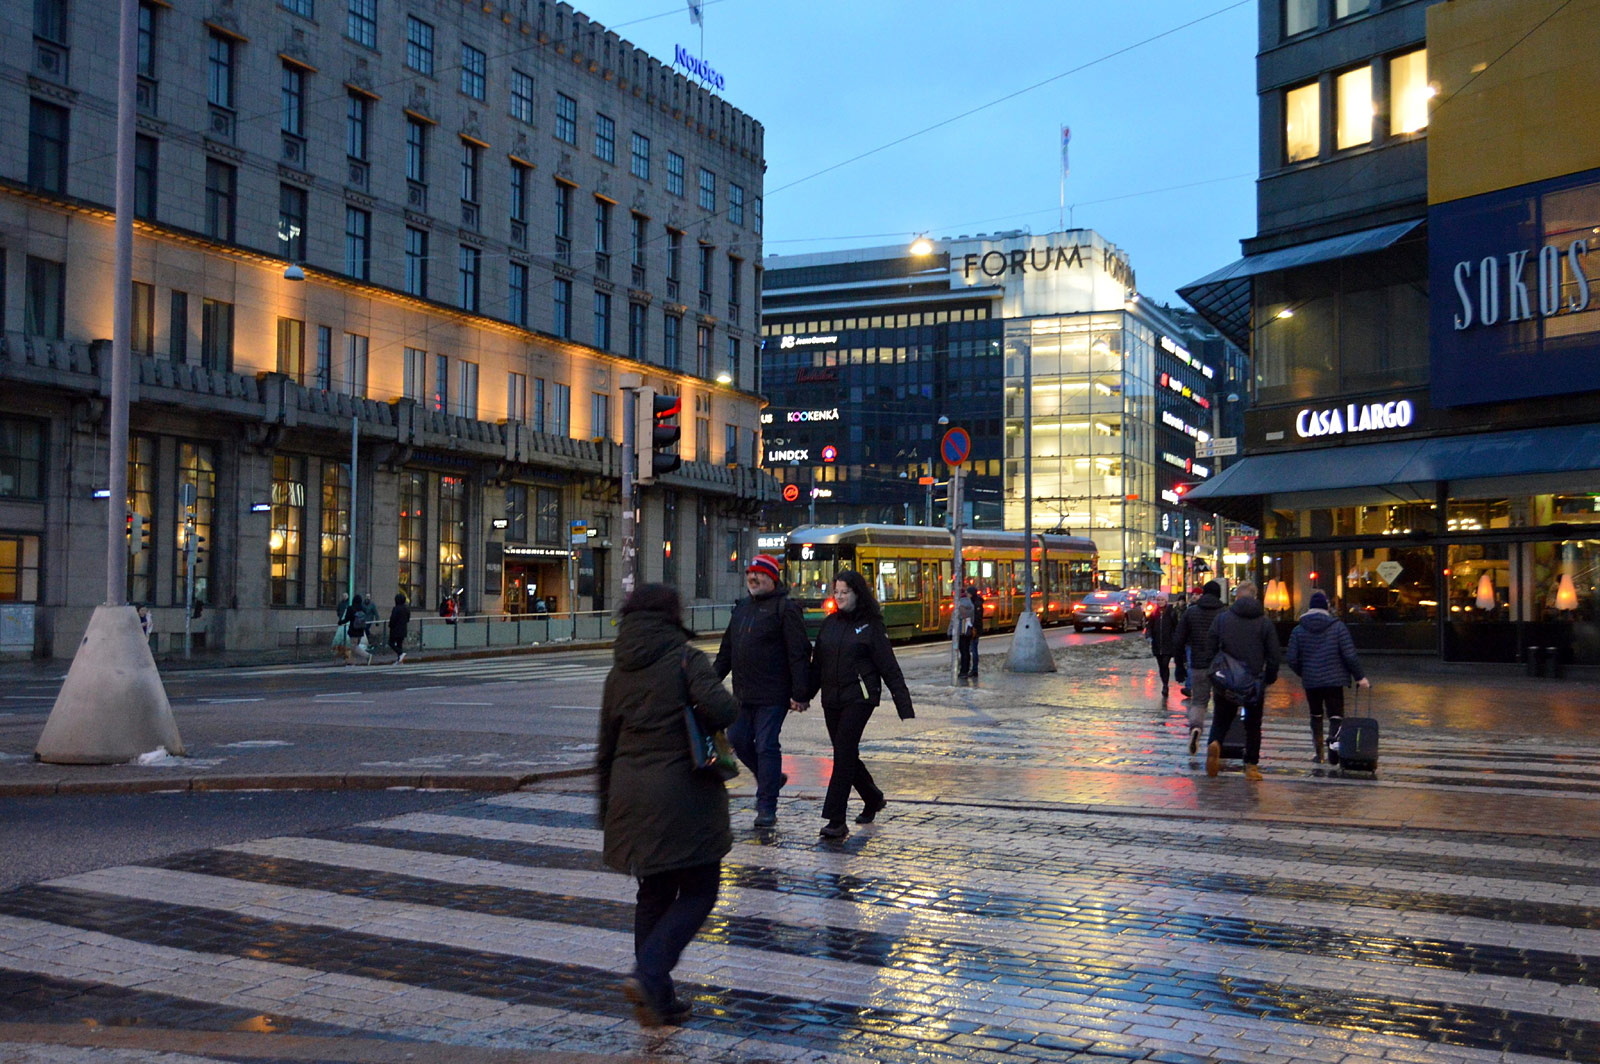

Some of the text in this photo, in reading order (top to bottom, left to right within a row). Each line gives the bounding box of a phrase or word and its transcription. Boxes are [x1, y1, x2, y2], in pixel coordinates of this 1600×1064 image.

[964, 244, 1083, 278] FORUM
[1453, 239, 1590, 331] SOKOS
[787, 408, 840, 422] KOOKENKÄ
[1296, 400, 1412, 438] CASA LARGO
[758, 536, 788, 547] mari
